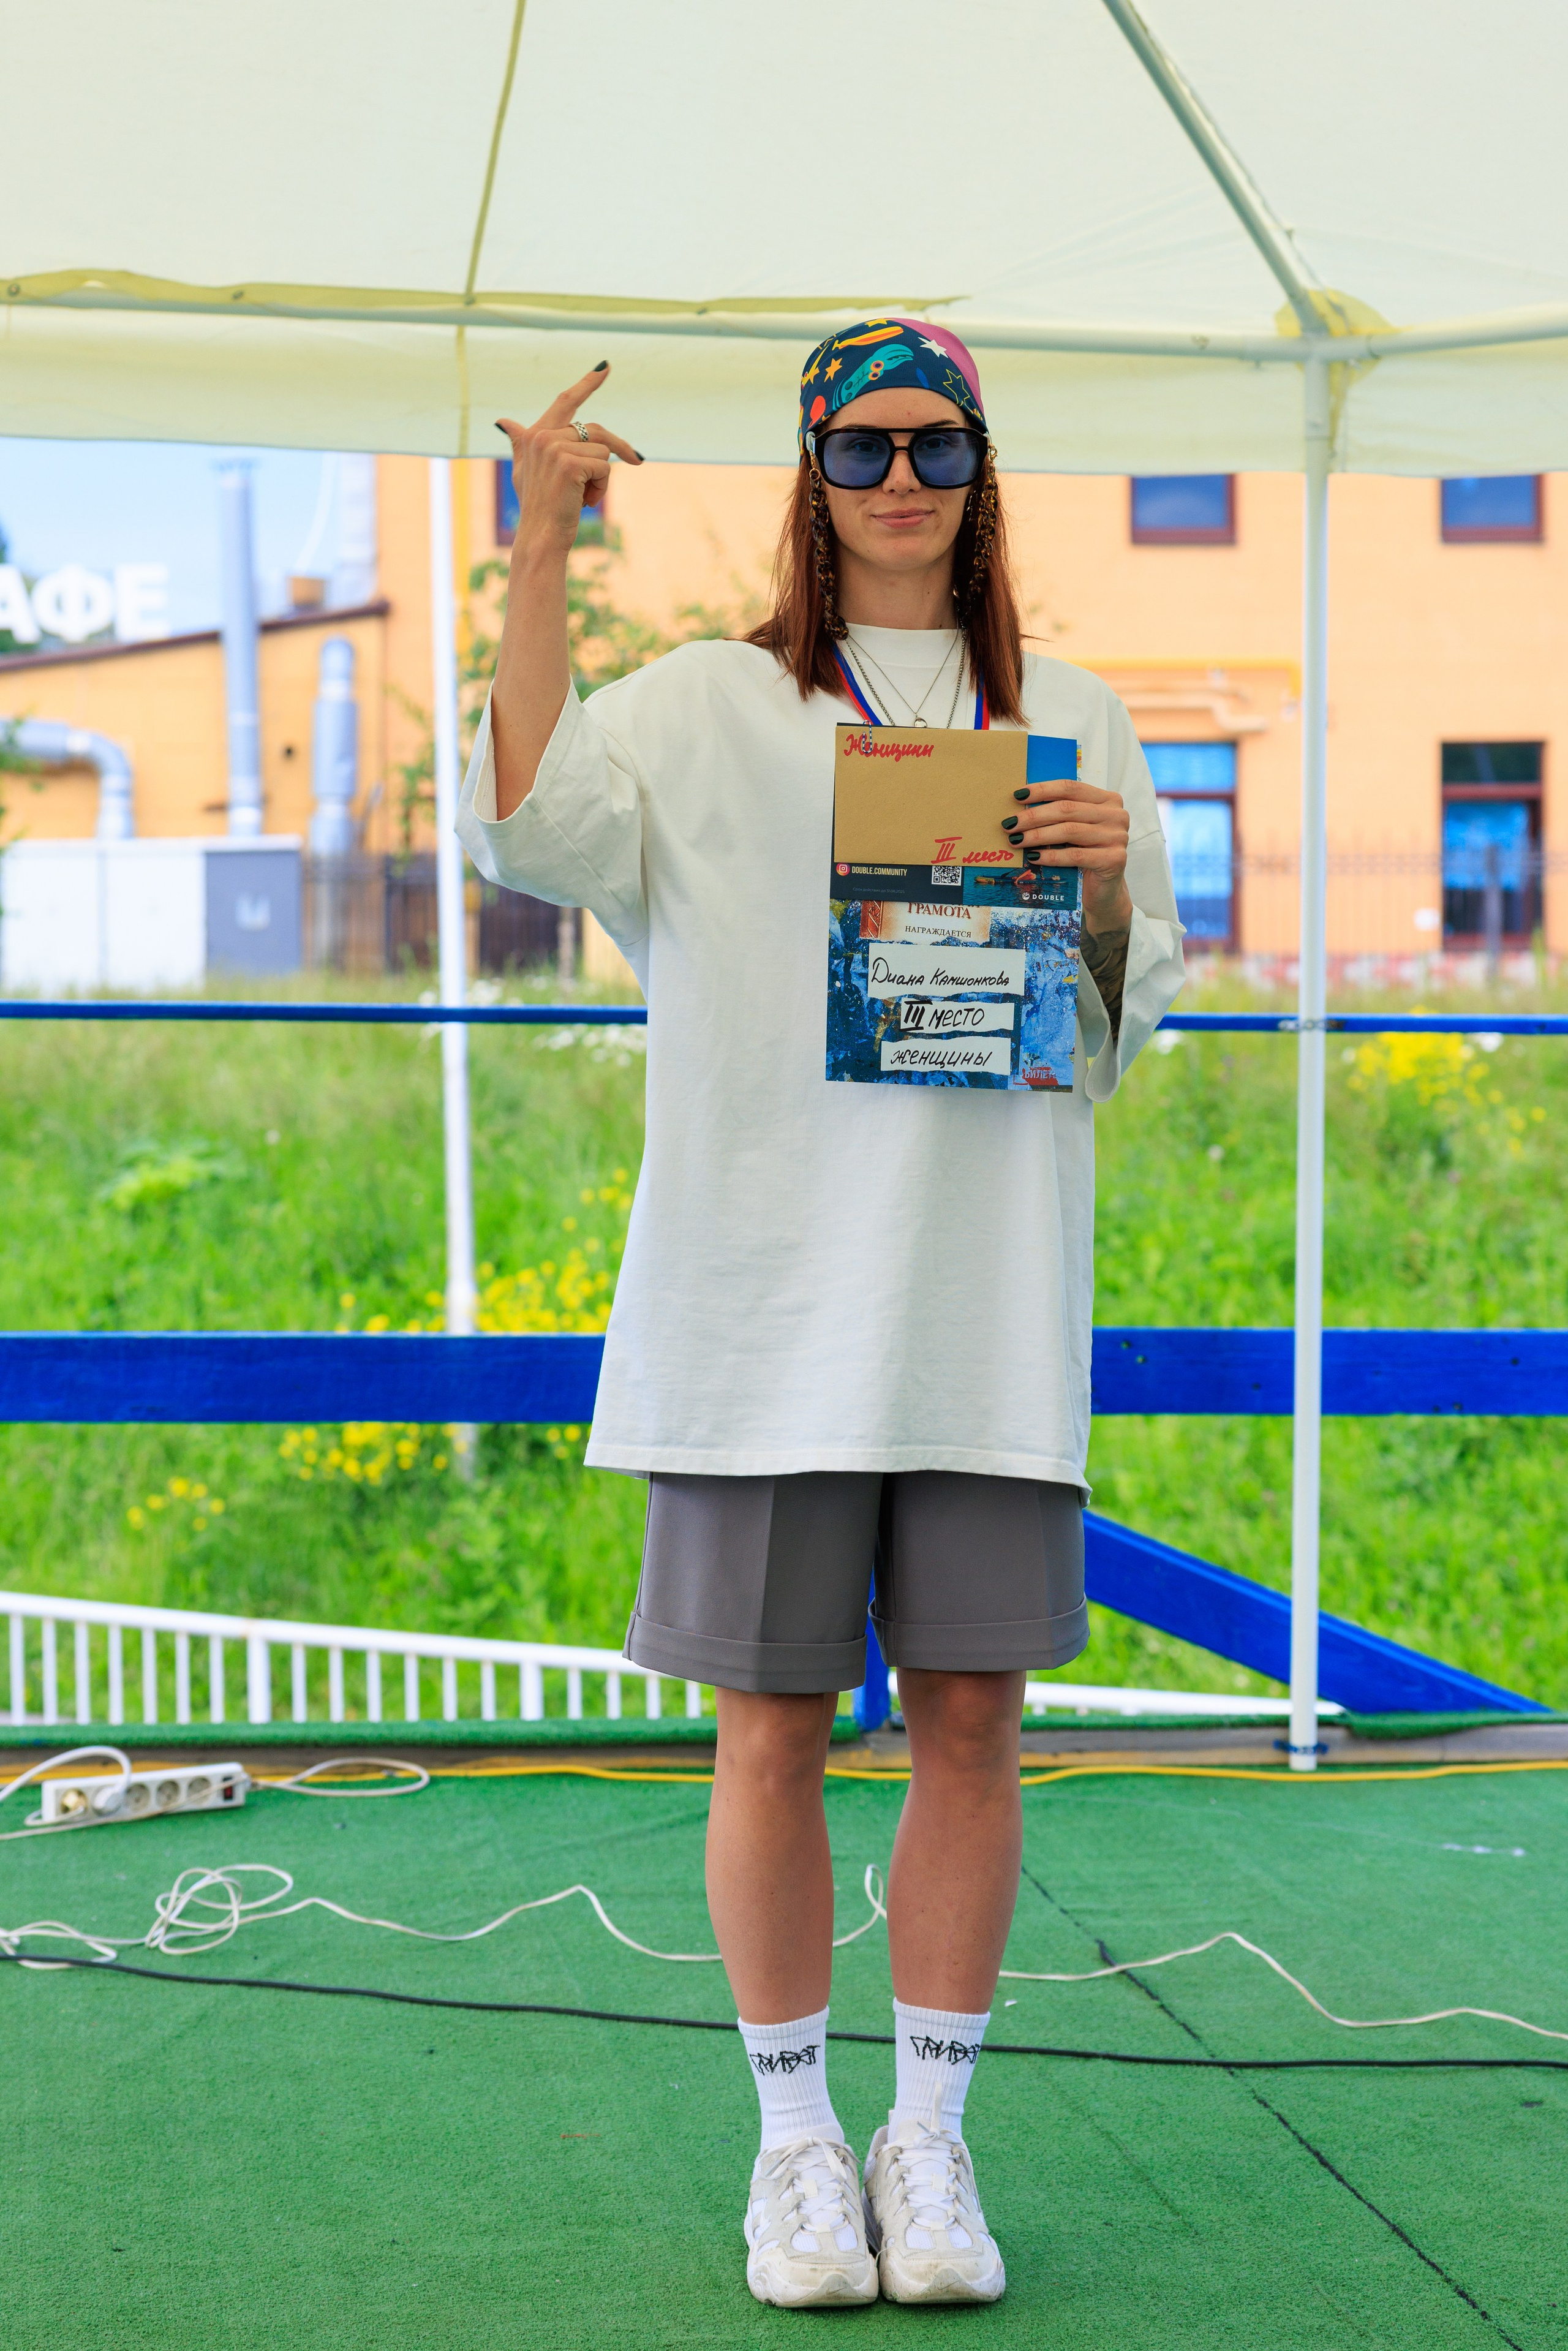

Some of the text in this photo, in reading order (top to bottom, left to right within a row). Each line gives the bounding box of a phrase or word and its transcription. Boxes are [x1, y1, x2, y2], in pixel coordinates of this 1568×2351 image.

[851, 866, 908, 877] DOUBLE.COMMUNITY
[907, 902, 972, 919] ГРАМОТА
[905, 926, 971, 938] НАГРАЖДАЕТСЯ
[871, 957, 925, 987] Диана
[890, 1049, 993, 1069] женщины
